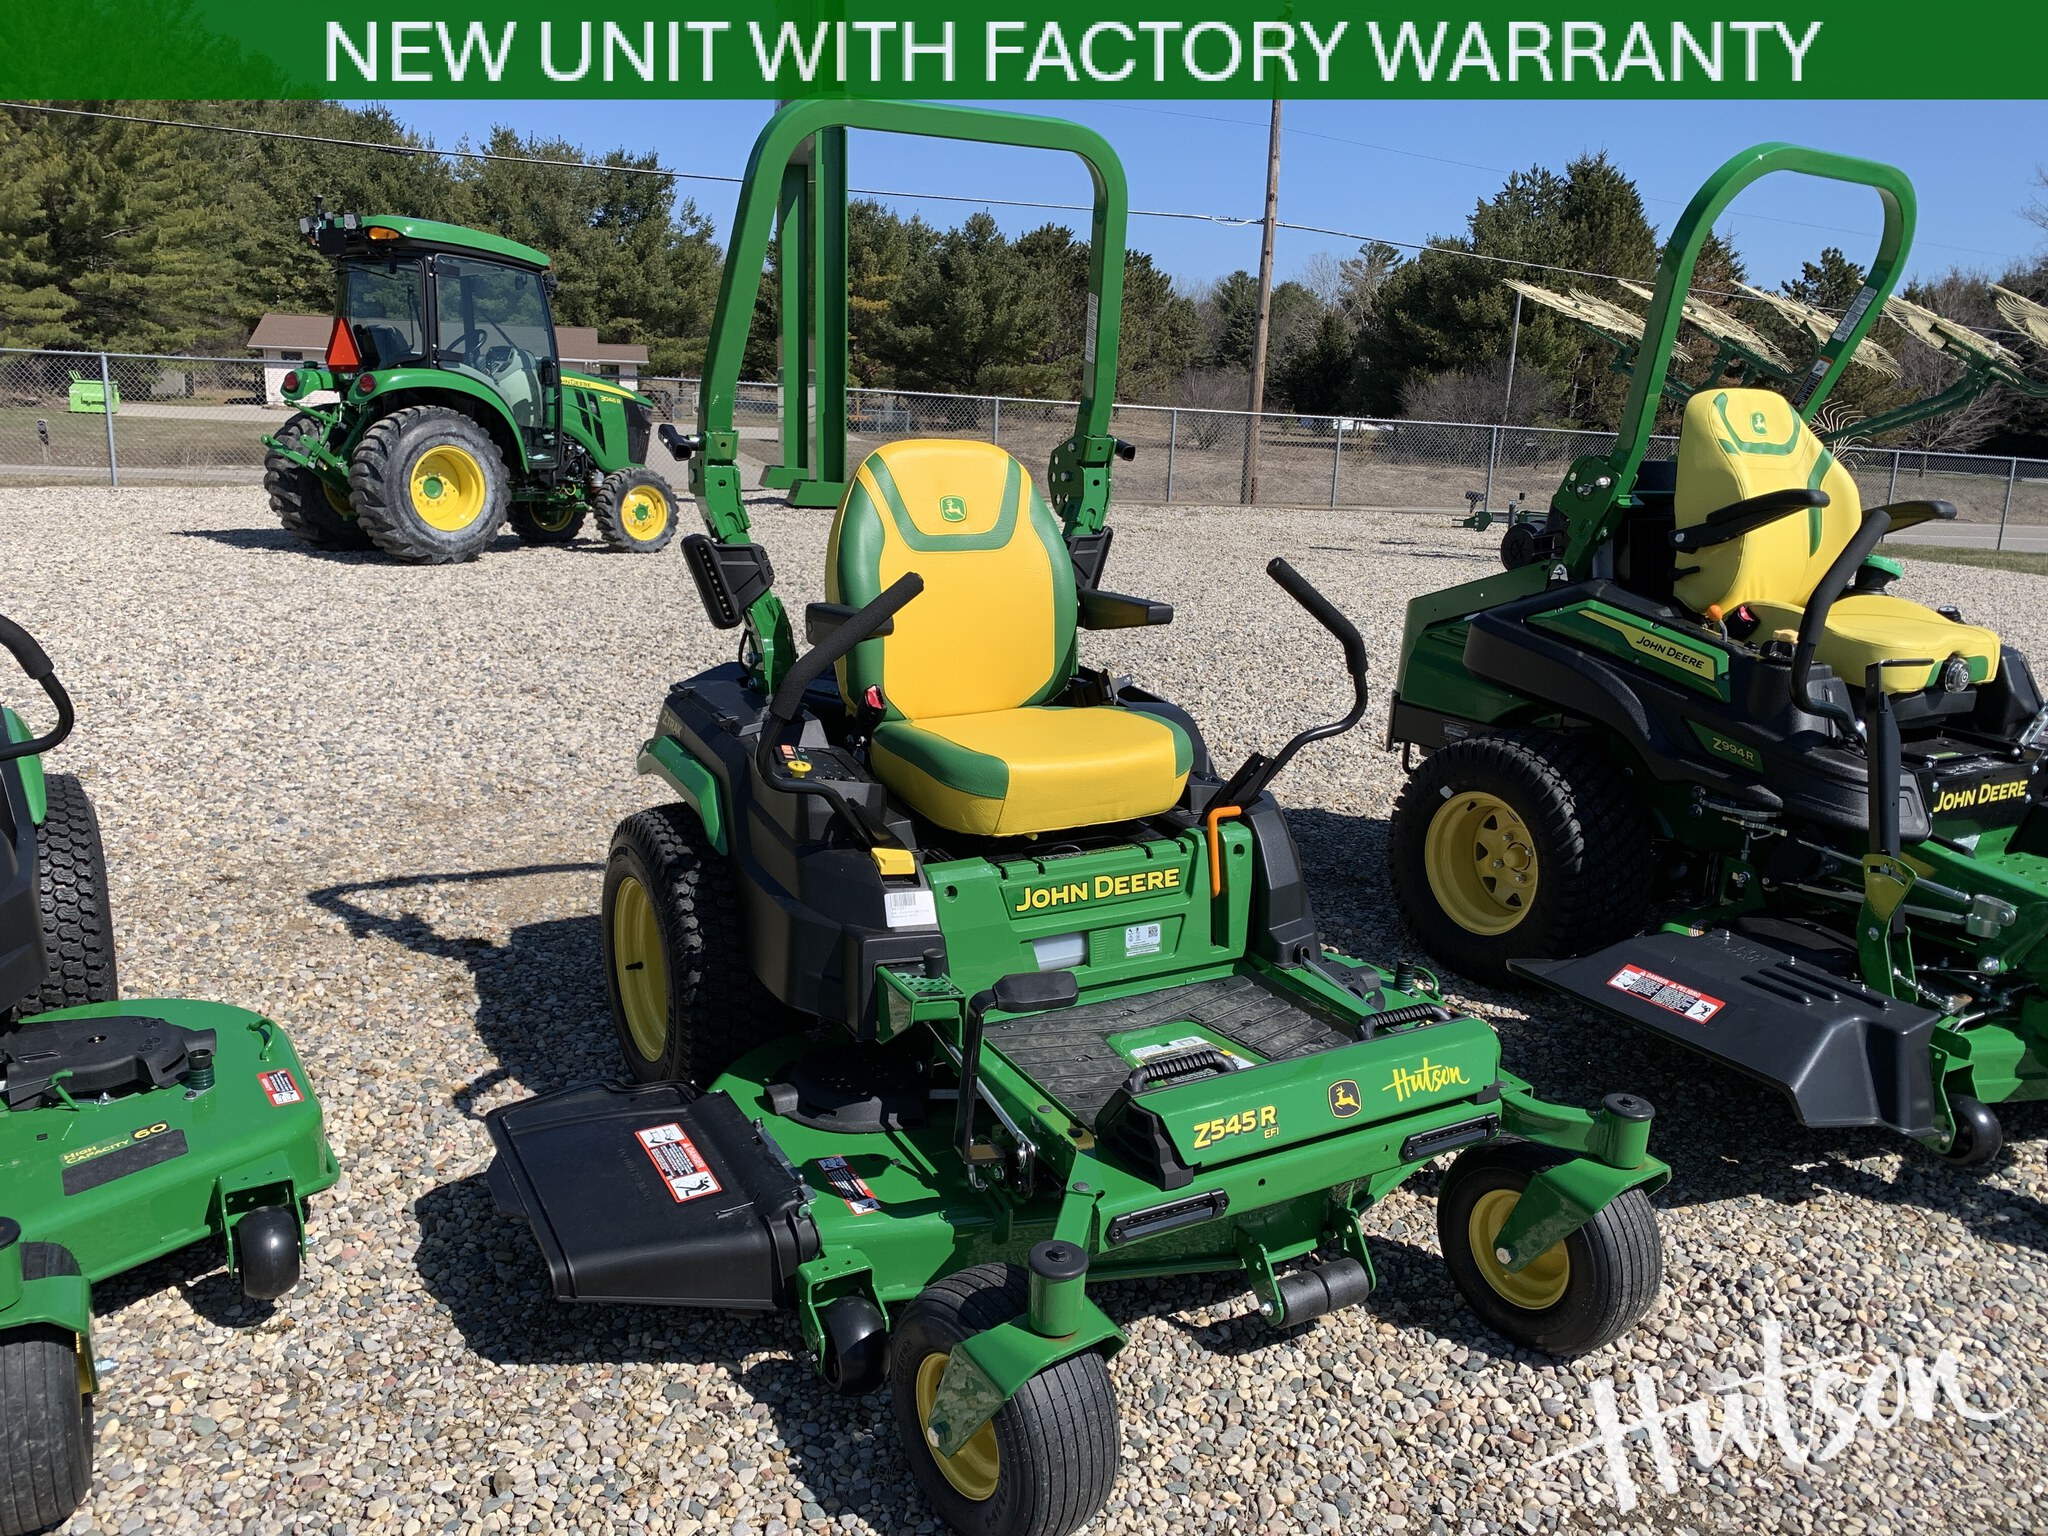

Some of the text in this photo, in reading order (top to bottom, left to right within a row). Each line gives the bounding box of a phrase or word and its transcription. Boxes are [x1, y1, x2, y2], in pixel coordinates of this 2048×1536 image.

[1636, 636, 1705, 669] JOHN DEERE
[1932, 779, 2030, 813] JOHN DEERE
[1015, 867, 1181, 913] JOHN DEERE
[1645, 972, 1671, 986] DANGER
[1382, 1056, 1471, 1103] Hutson
[134, 1123, 168, 1139] 60
[1264, 1127, 1280, 1140] EFI
[63, 1146, 97, 1161] HIGH
[66, 1139, 129, 1164] CAPACITY
[685, 1145, 706, 1169] DANGER
